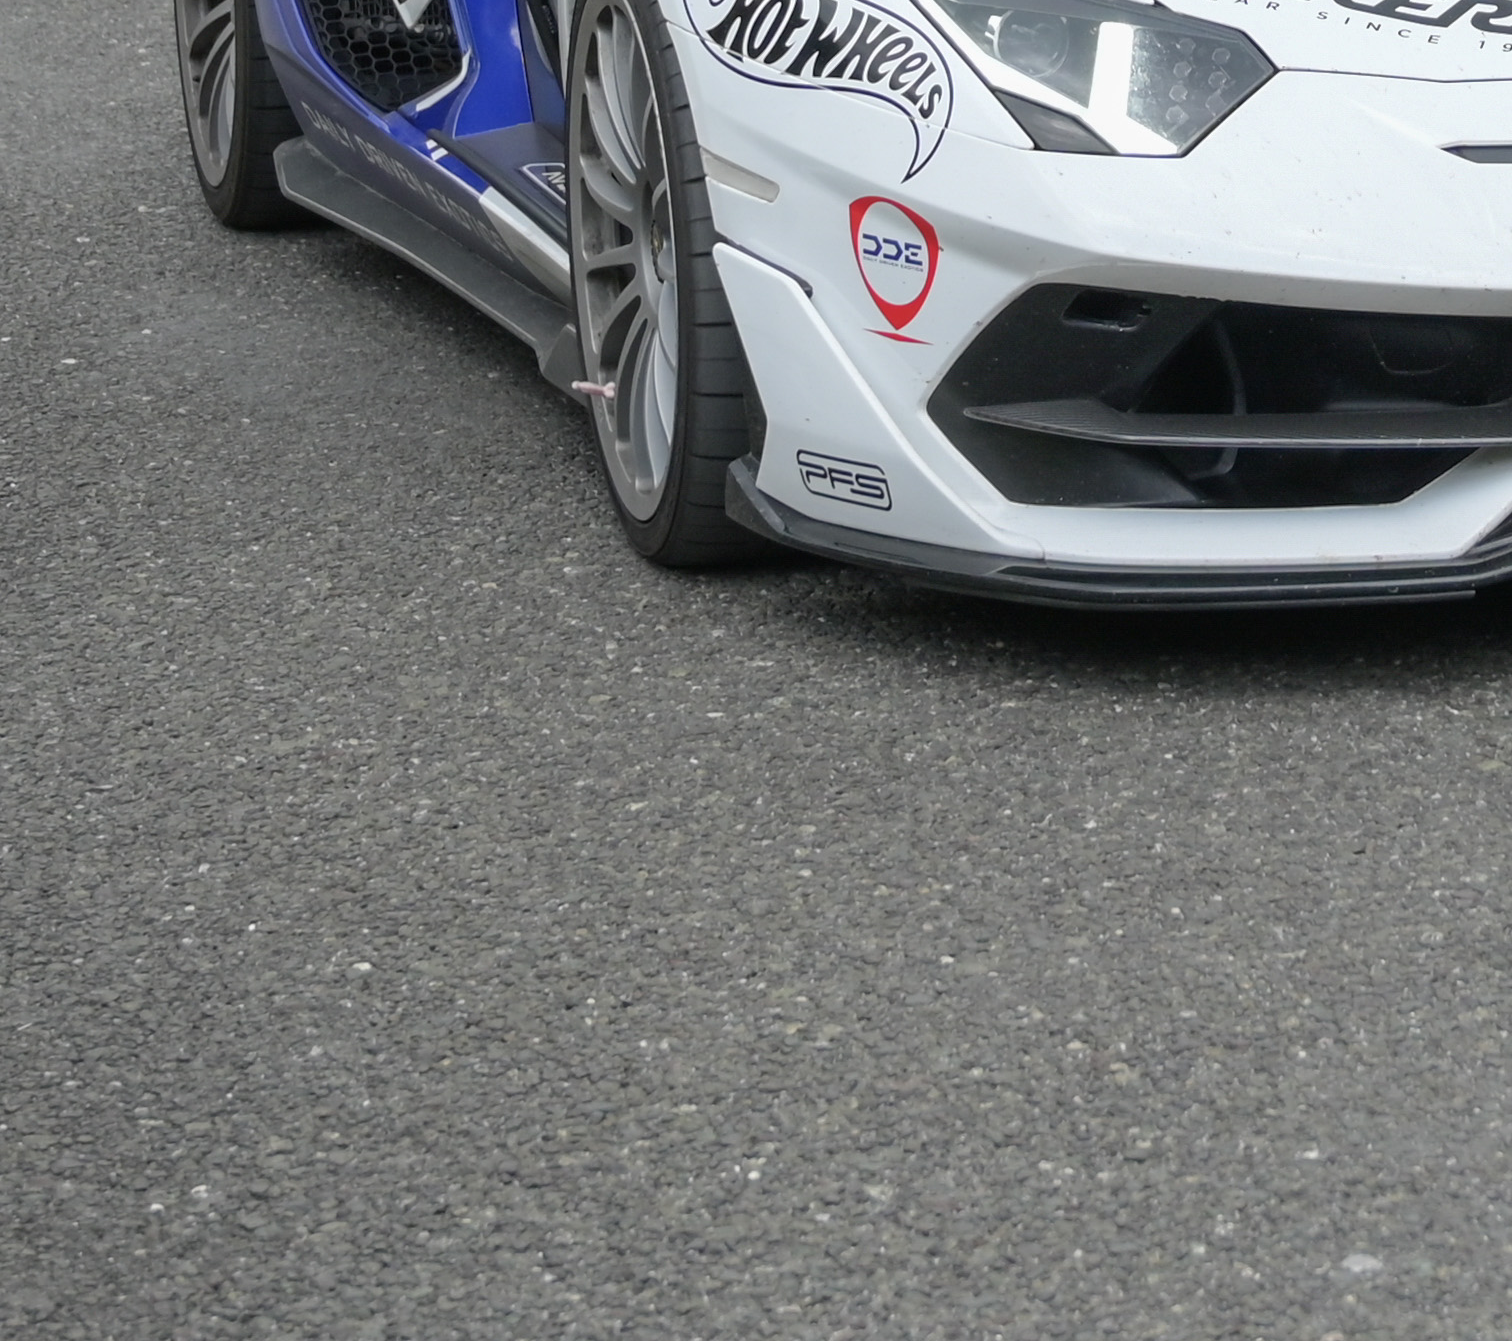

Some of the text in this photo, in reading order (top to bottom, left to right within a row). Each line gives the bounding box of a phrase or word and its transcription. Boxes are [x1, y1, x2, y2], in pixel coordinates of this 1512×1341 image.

[1317, 10, 1441, 45] SINCE
[862, 232, 923, 267] DDE
[799, 461, 887, 500] PFS
